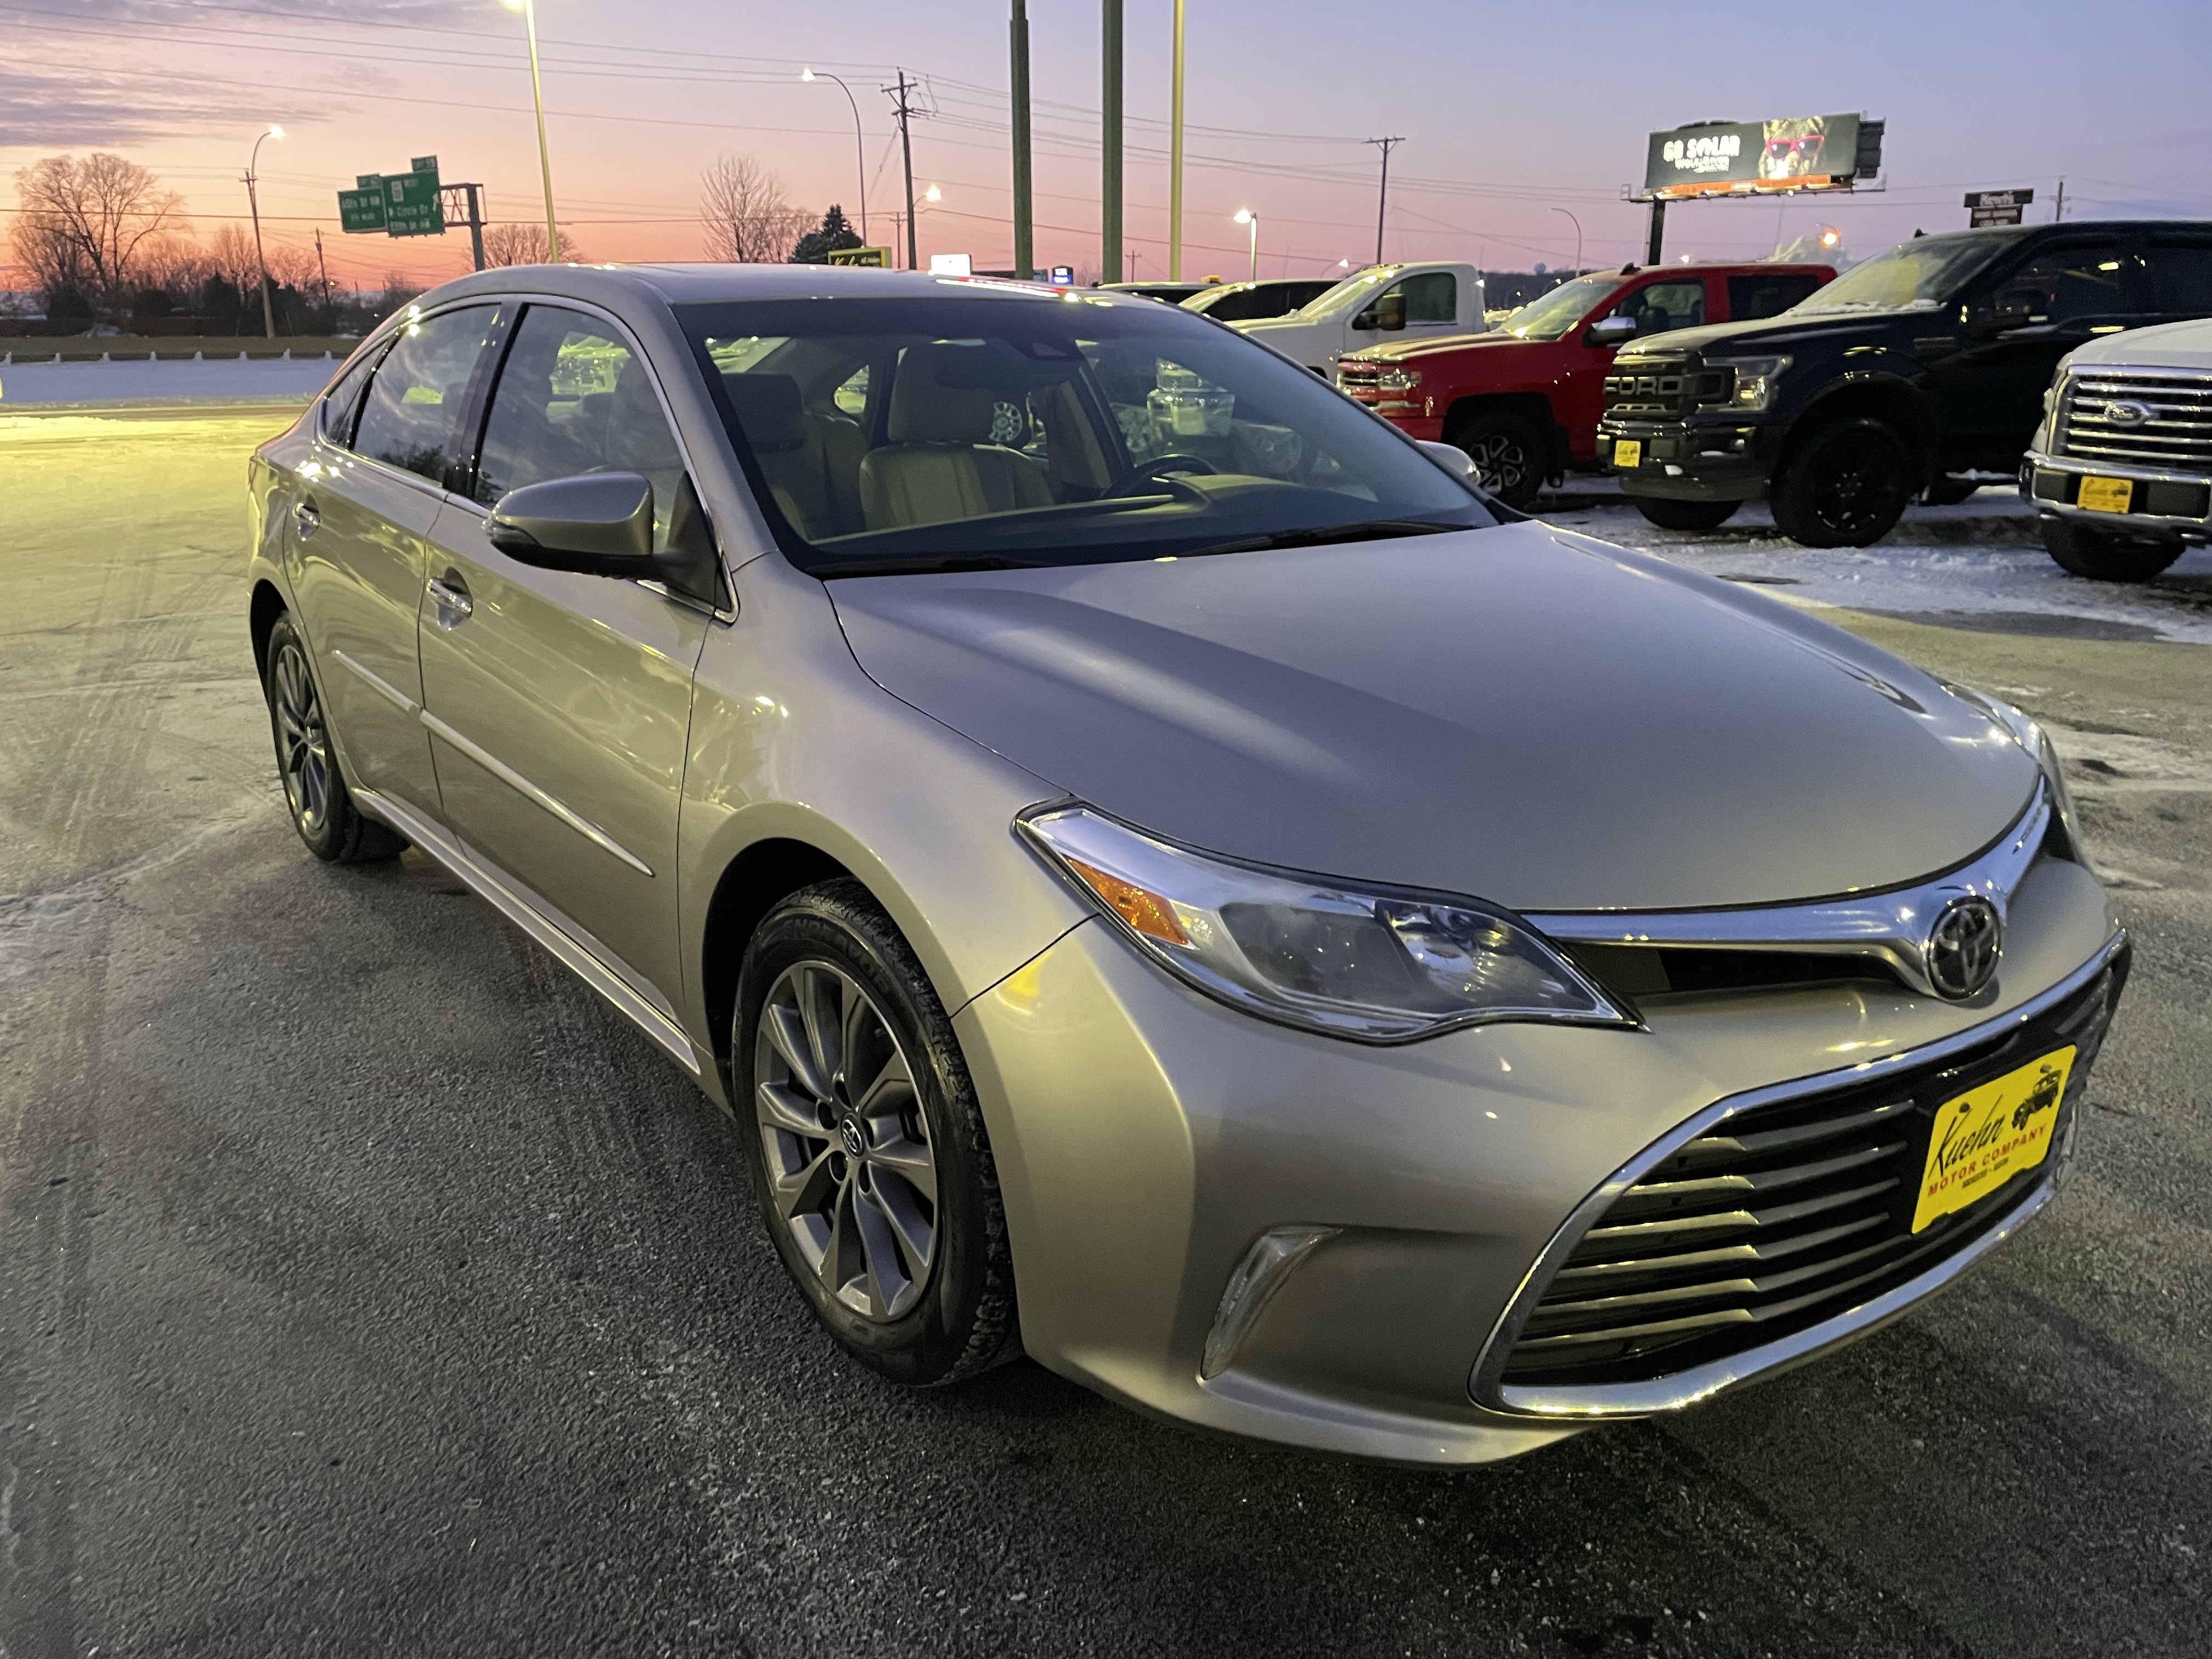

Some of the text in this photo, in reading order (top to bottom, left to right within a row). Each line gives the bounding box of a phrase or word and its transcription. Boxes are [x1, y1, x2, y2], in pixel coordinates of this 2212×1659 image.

[1603, 376, 1683, 395] FORD
[1928, 1161, 1977, 1197] MOTOR
[1982, 1123, 2046, 1166] COMPANY
